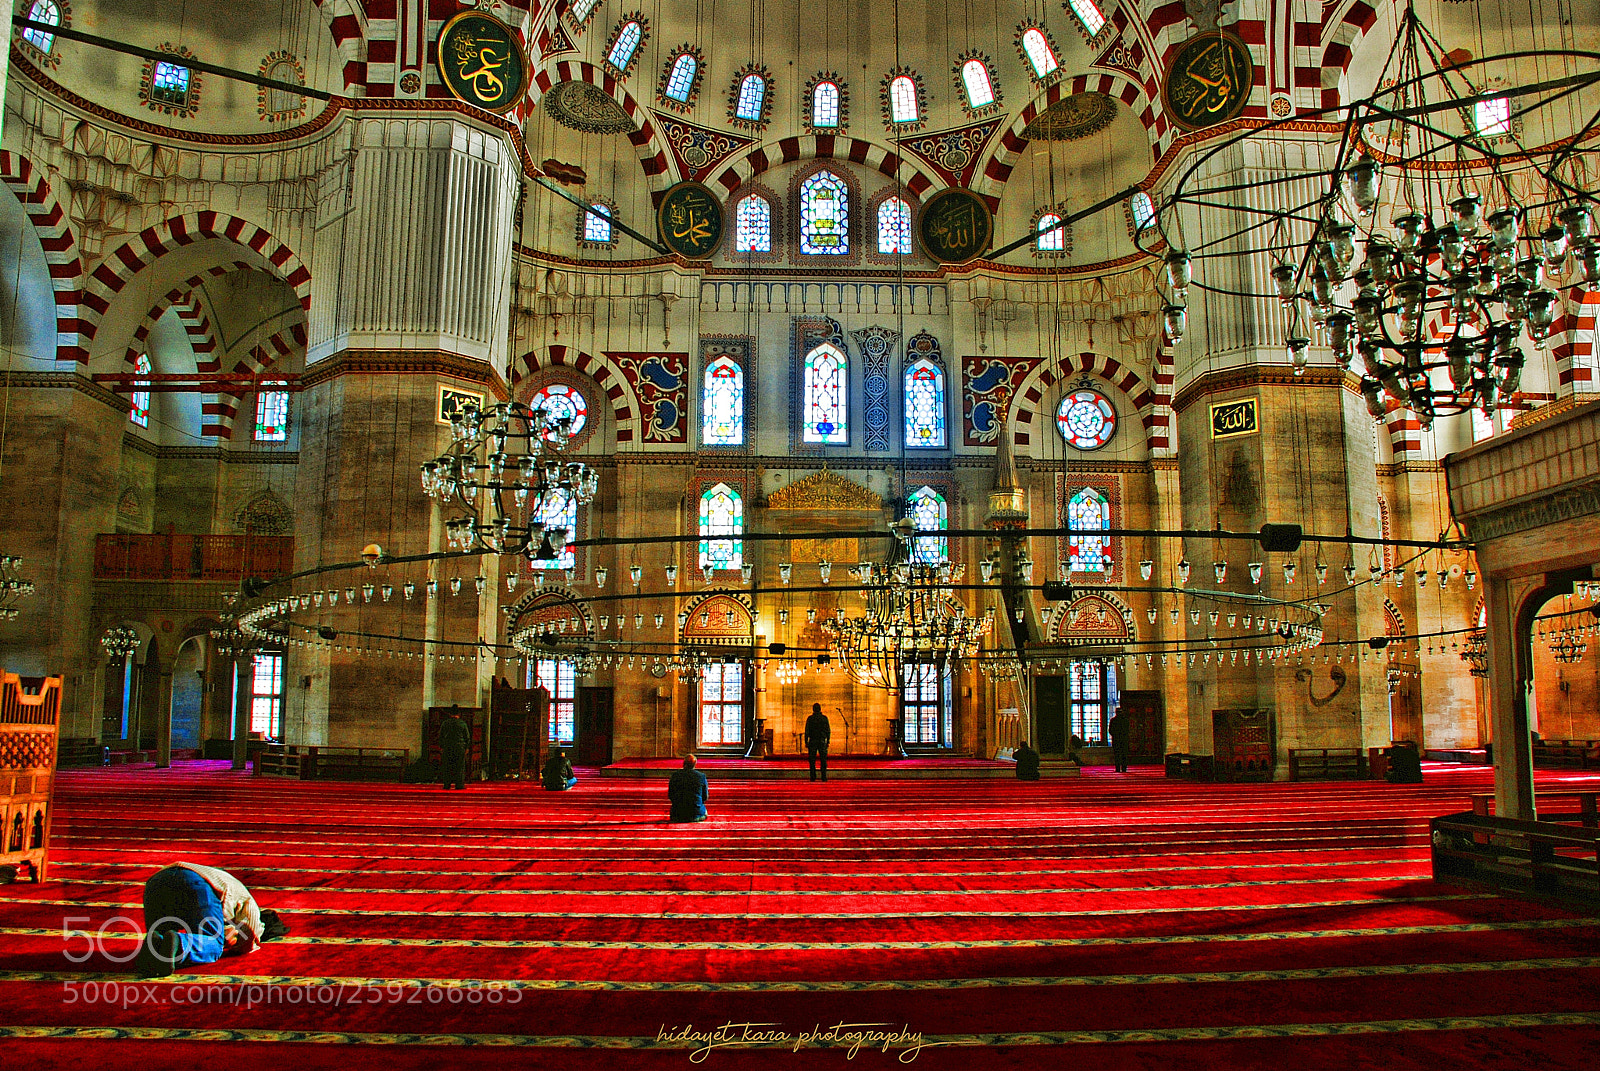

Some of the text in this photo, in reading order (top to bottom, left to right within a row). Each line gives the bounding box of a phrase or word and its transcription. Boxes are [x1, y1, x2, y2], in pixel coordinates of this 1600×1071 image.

[673, 209, 712, 247] محمد
[940, 204, 976, 249] الله
[1222, 405, 1247, 429] الله
